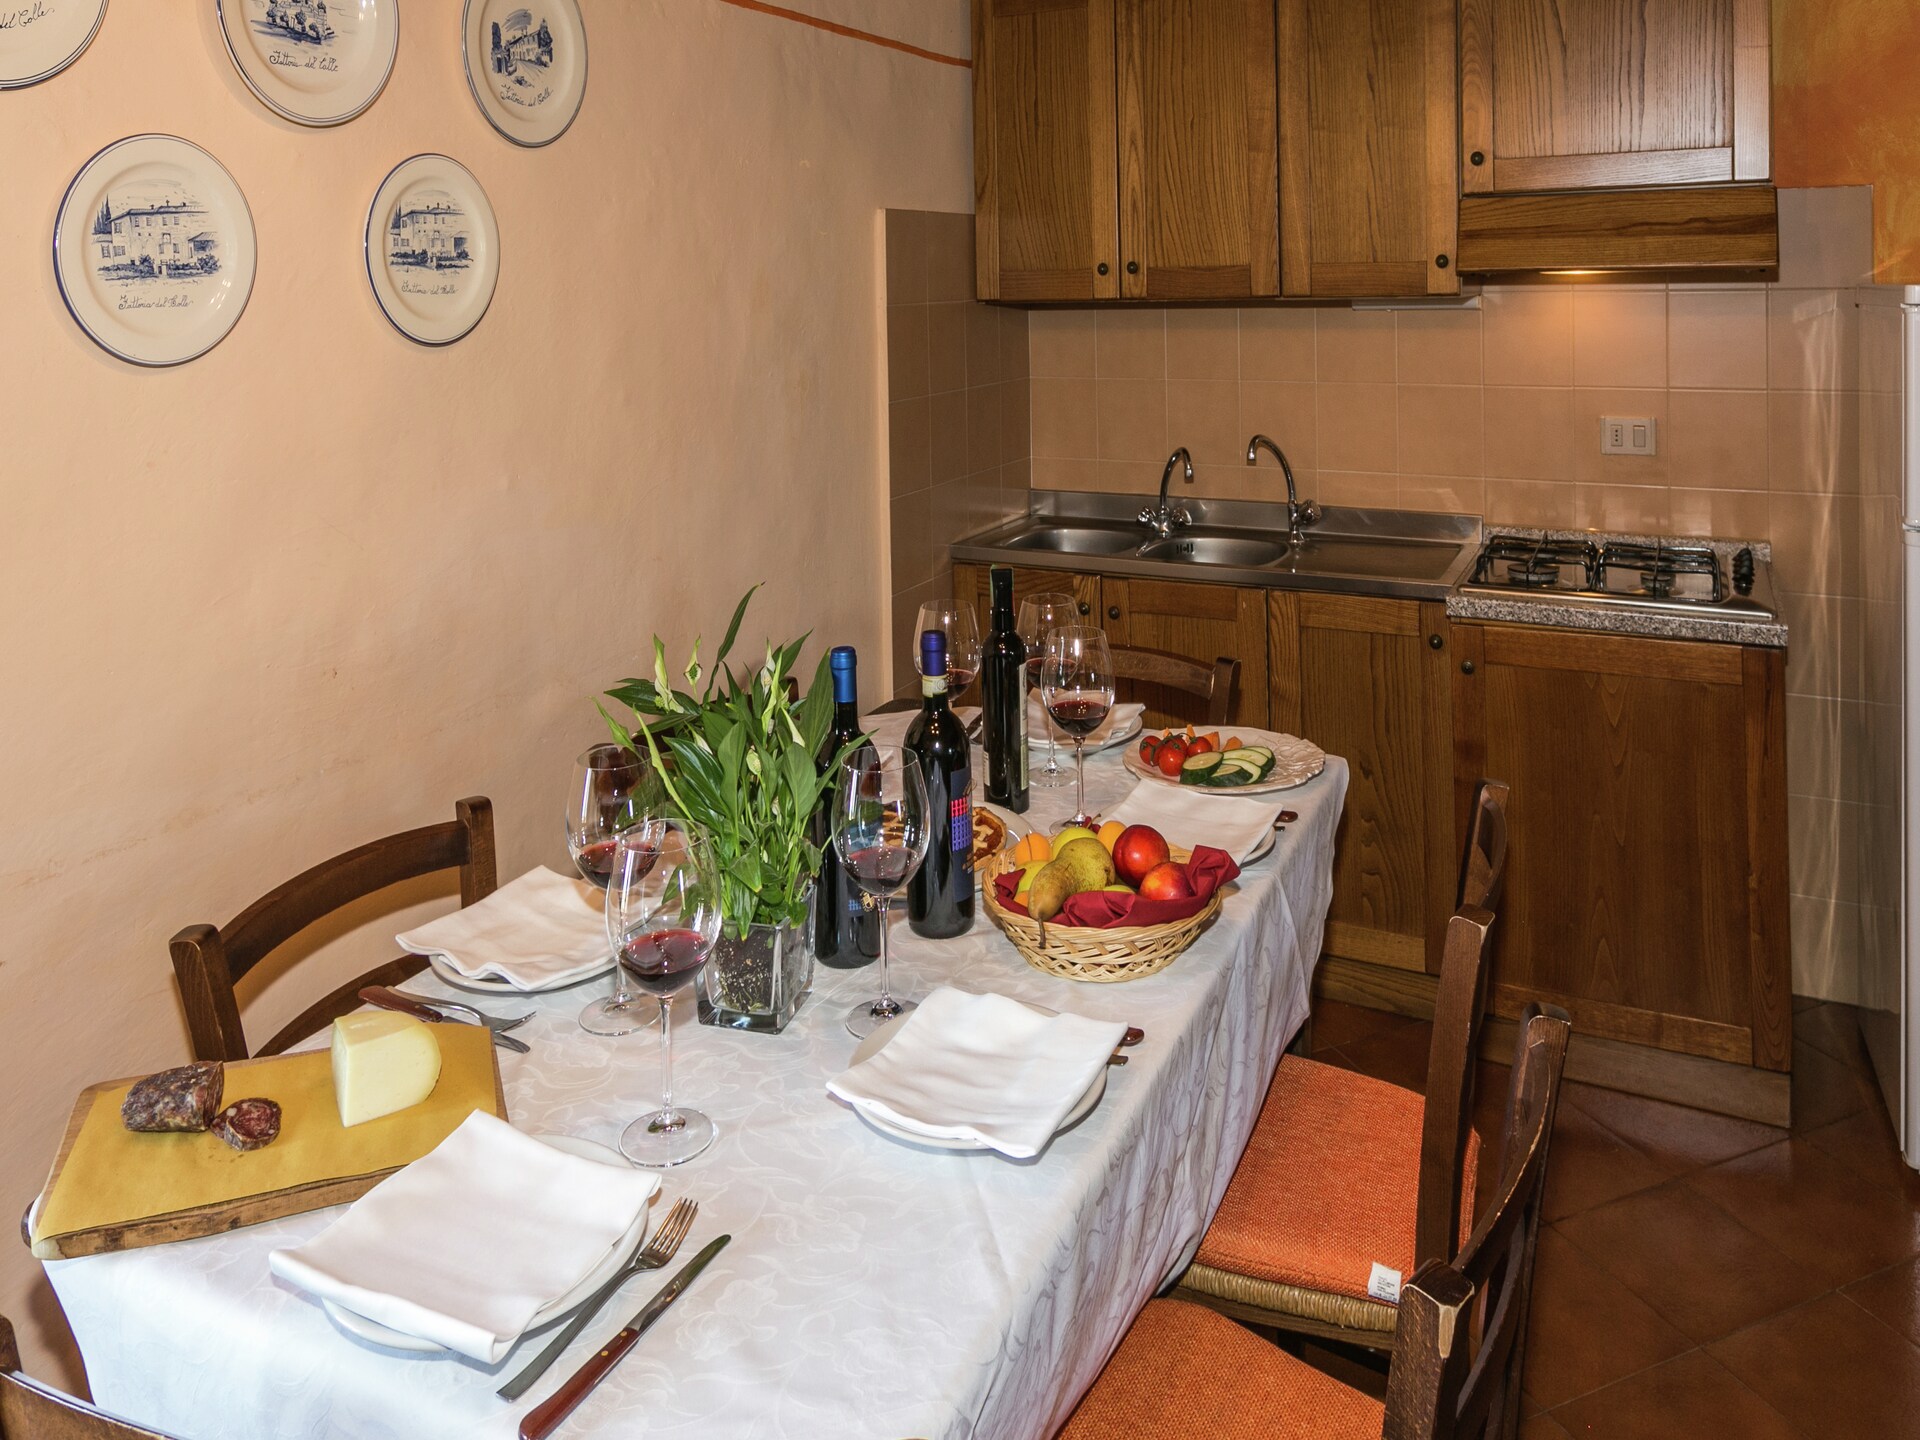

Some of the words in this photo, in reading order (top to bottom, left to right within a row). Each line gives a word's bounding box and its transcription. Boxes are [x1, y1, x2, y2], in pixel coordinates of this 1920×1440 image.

[18, 1, 55, 27] Colle
[304, 56, 318, 70] del
[118, 294, 155, 310] Fattoria
[155, 297, 168, 308] del
[168, 295, 194, 308] Colle
